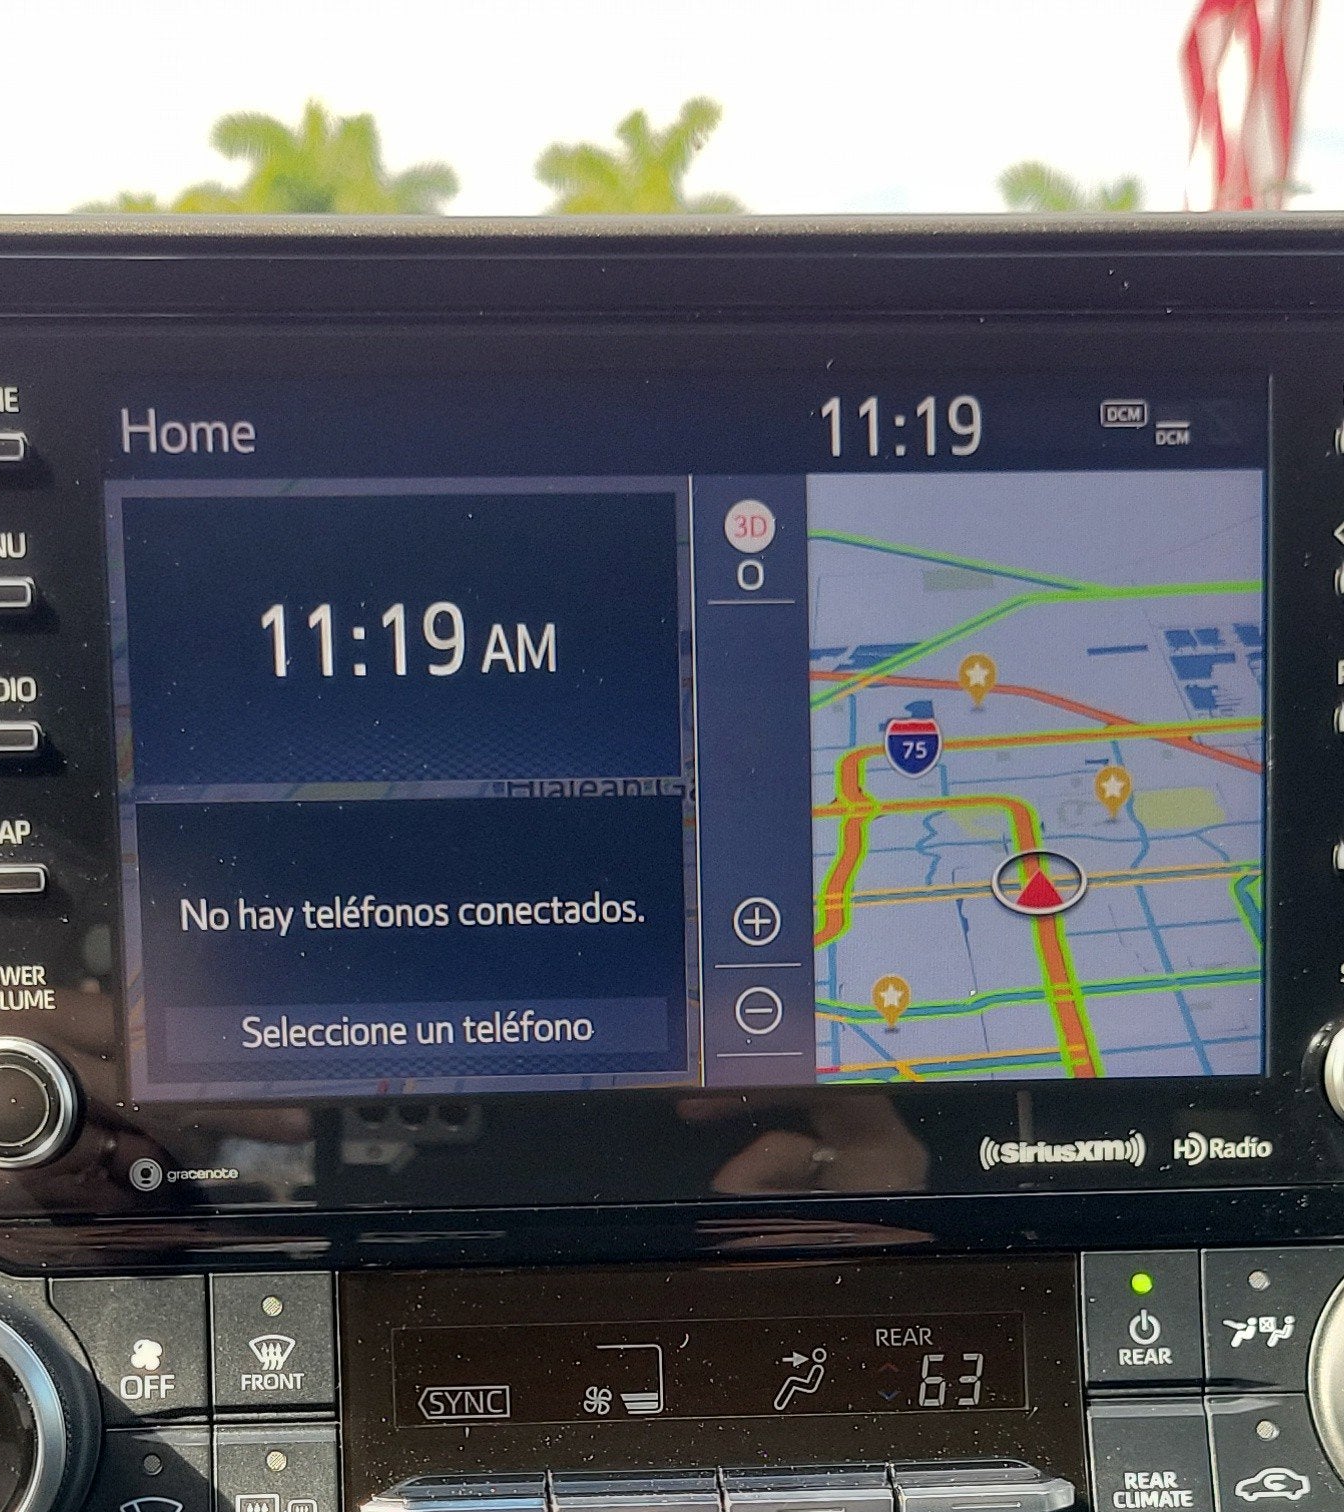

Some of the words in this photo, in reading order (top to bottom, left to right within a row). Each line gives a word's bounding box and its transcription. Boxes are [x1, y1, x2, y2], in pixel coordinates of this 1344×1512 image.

[820, 394, 982, 458] 11:19
[1107, 407, 1140, 422] DCM
[121, 408, 256, 454] Home
[1156, 429, 1190, 446] DCM
[735, 514, 768, 538] 3D
[261, 601, 466, 678] 11:19
[481, 622, 556, 673] AM
[902, 740, 928, 761] 75
[180, 899, 229, 932] No
[238, 897, 294, 937] hay
[303, 894, 450, 930] teléfonos
[458, 891, 646, 927] conectados.
[242, 1017, 407, 1049] Seleccione
[417, 1023, 454, 1046] un
[463, 1012, 594, 1044] teléfono
[1209, 1136, 1273, 1159] Radio
[166, 1167, 240, 1183] gracenote
[875, 1328, 933, 1348] REAR
[1118, 1347, 1173, 1366] REAR
[119, 1374, 176, 1400] OFF
[241, 1372, 305, 1391] FRONT
[918, 1353, 984, 1407] 63
[427, 1388, 504, 1416] SYNC
[1124, 1471, 1179, 1491] REAR
[1112, 1490, 1194, 1509] CLIMATE
